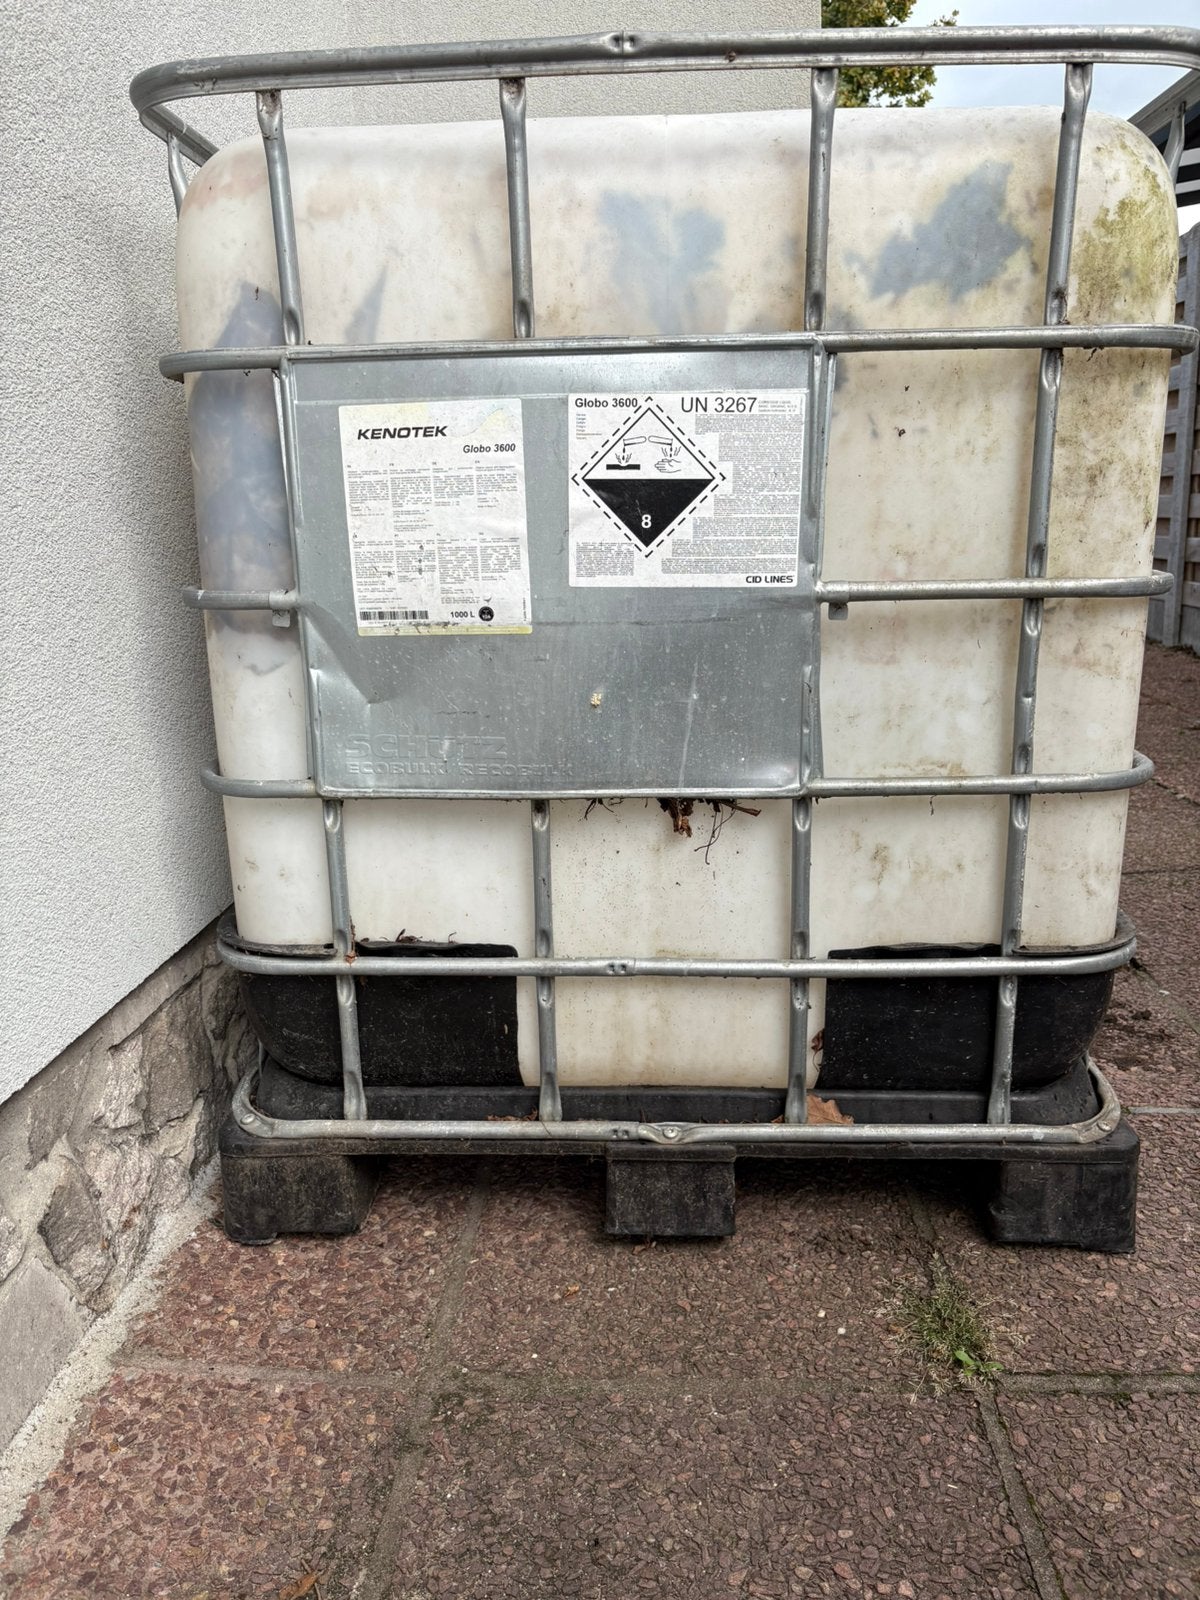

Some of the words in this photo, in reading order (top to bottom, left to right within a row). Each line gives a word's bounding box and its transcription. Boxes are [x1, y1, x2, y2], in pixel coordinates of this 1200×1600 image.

[574, 397, 608, 408] Globo
[611, 397, 638, 408] 3600
[681, 396, 708, 413] UN
[713, 396, 758, 413] 3267
[357, 426, 448, 440] KENOTEK
[462, 444, 492, 454] Globo
[493, 443, 516, 453] 3600
[641, 514, 651, 529] 8
[745, 575, 763, 584] CID
[764, 575, 794, 584] LINES
[450, 611, 469, 619] 1000
[470, 610, 476, 618] L
[347, 761, 448, 774] ECOBULK
